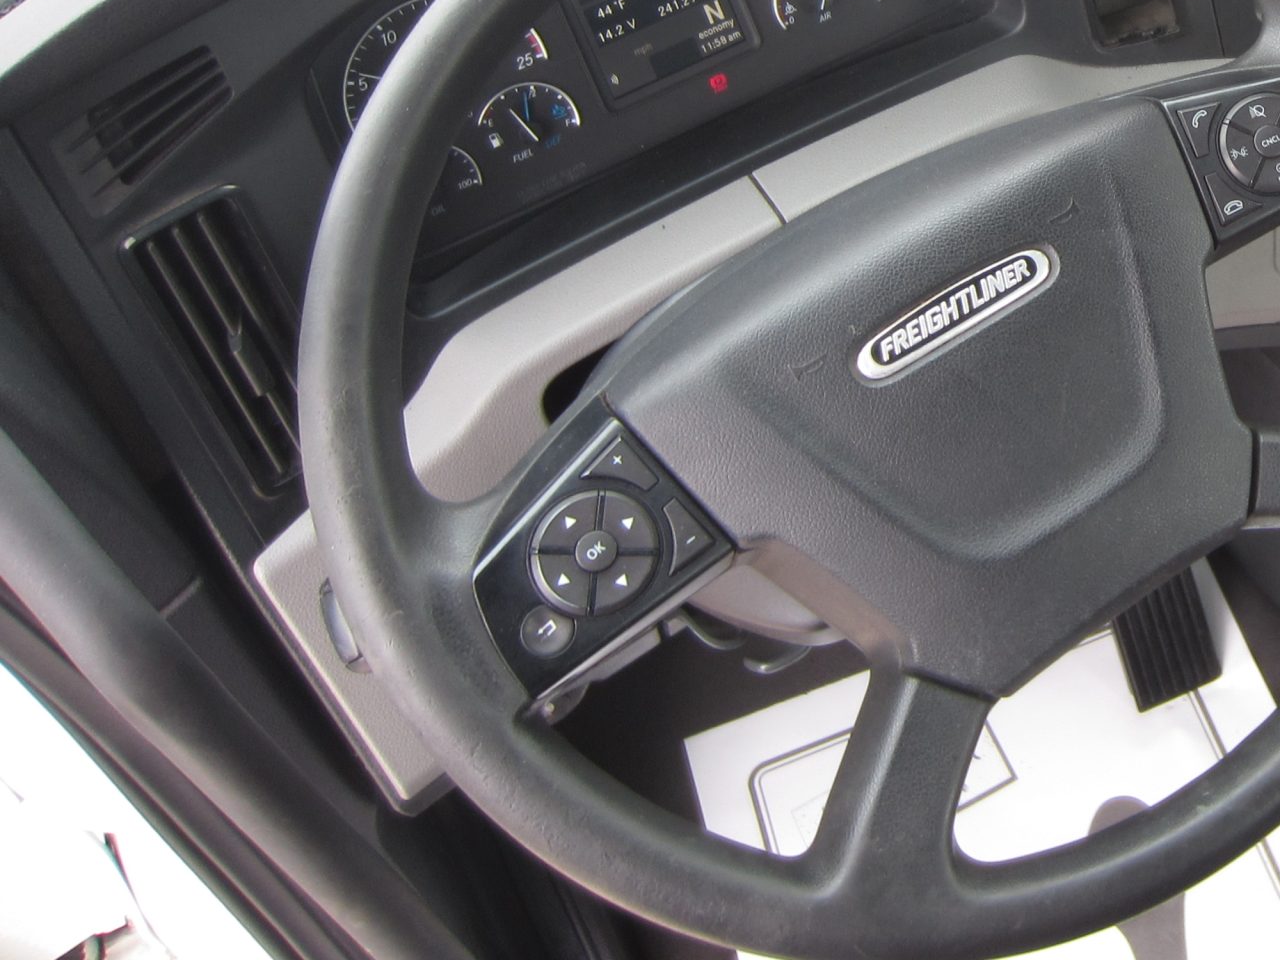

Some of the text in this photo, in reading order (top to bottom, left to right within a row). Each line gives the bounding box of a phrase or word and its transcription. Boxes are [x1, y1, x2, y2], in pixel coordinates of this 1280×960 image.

[597, 4, 613, 18] 44
[703, 0, 725, 25] N
[819, 12, 832, 23] AIR
[599, 18, 636, 43] 14.2 V
[698, 18, 735, 39] economy
[381, 30, 397, 46] 10
[701, 31, 742, 53] 11:58 am
[517, 54, 534, 70] 25
[358, 77, 368, 91] 5
[513, 148, 534, 163] FUEL
[457, 178, 472, 190] 100
[431, 204, 446, 216] OIL
[879, 258, 1031, 363] FREIGHTLINER
[586, 540, 607, 561] OK
